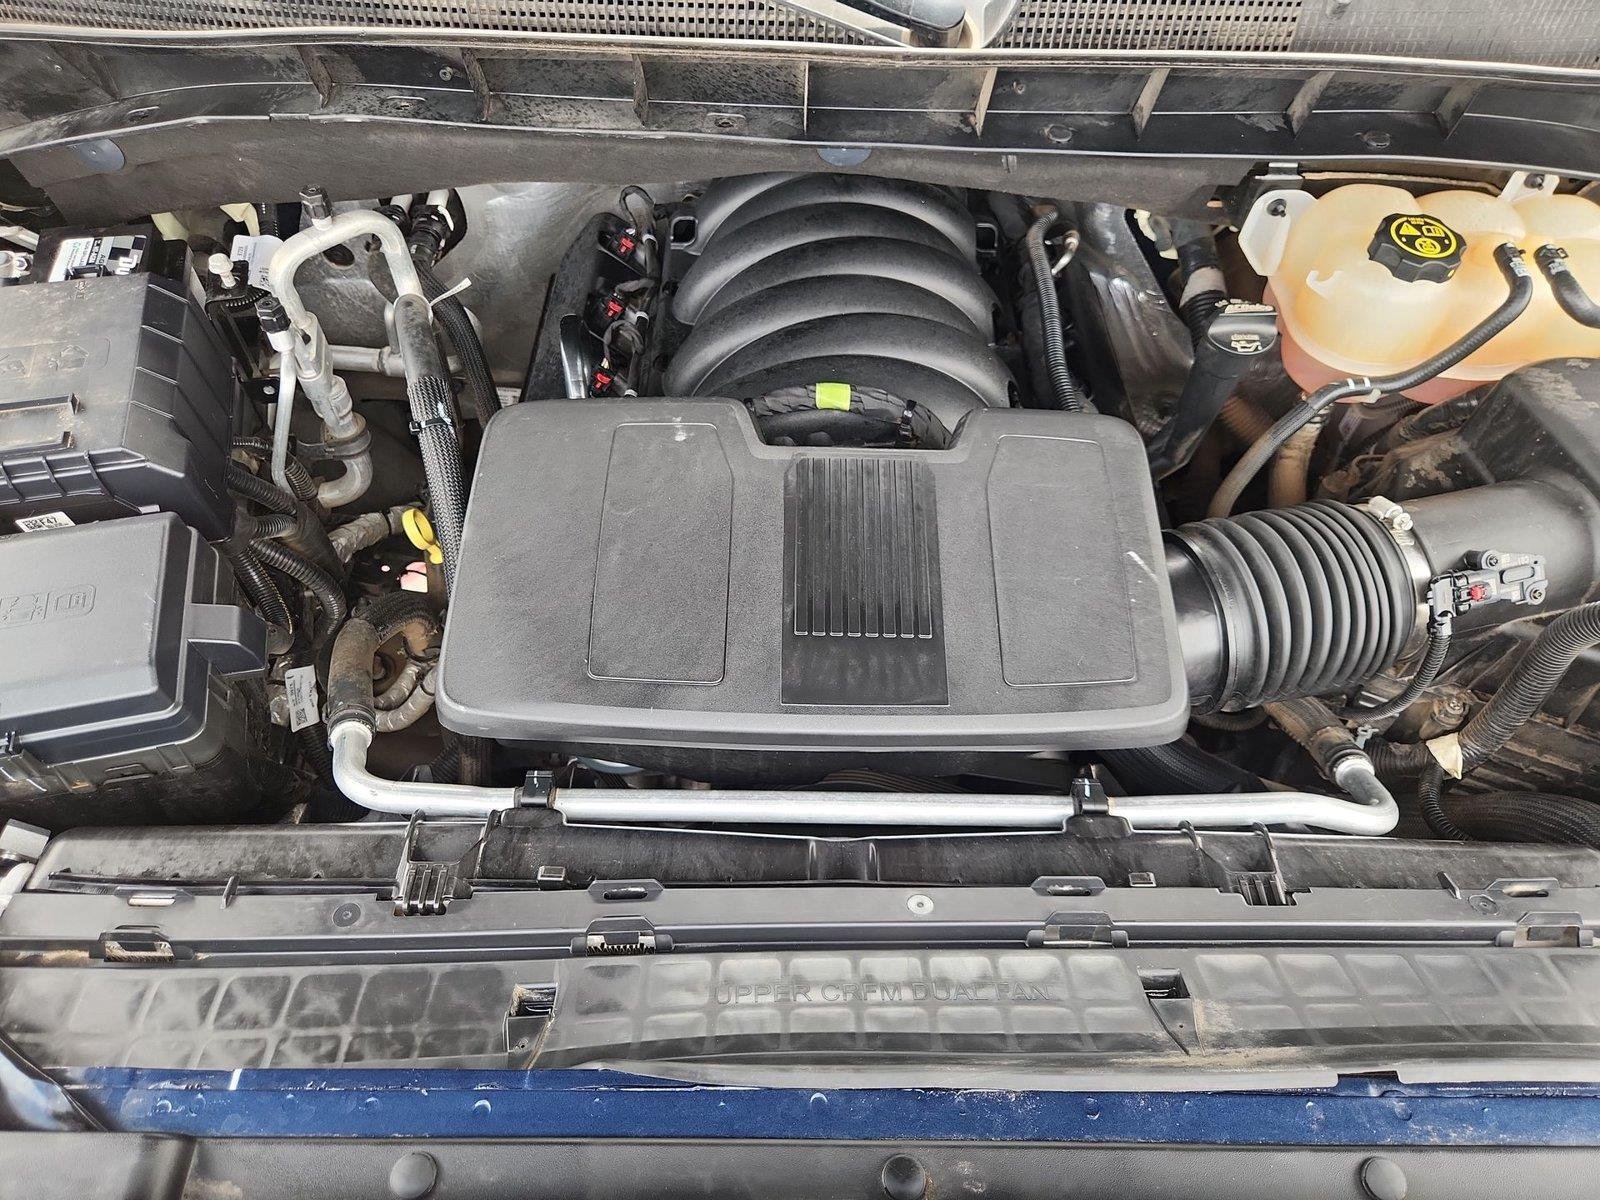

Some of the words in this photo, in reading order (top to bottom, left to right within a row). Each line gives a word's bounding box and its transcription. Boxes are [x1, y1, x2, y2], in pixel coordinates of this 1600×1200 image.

[715, 983, 813, 1005] UPPER
[821, 982, 902, 1001] CRFM
[911, 982, 989, 1001] DUAL
[996, 982, 1051, 1001] FAN
